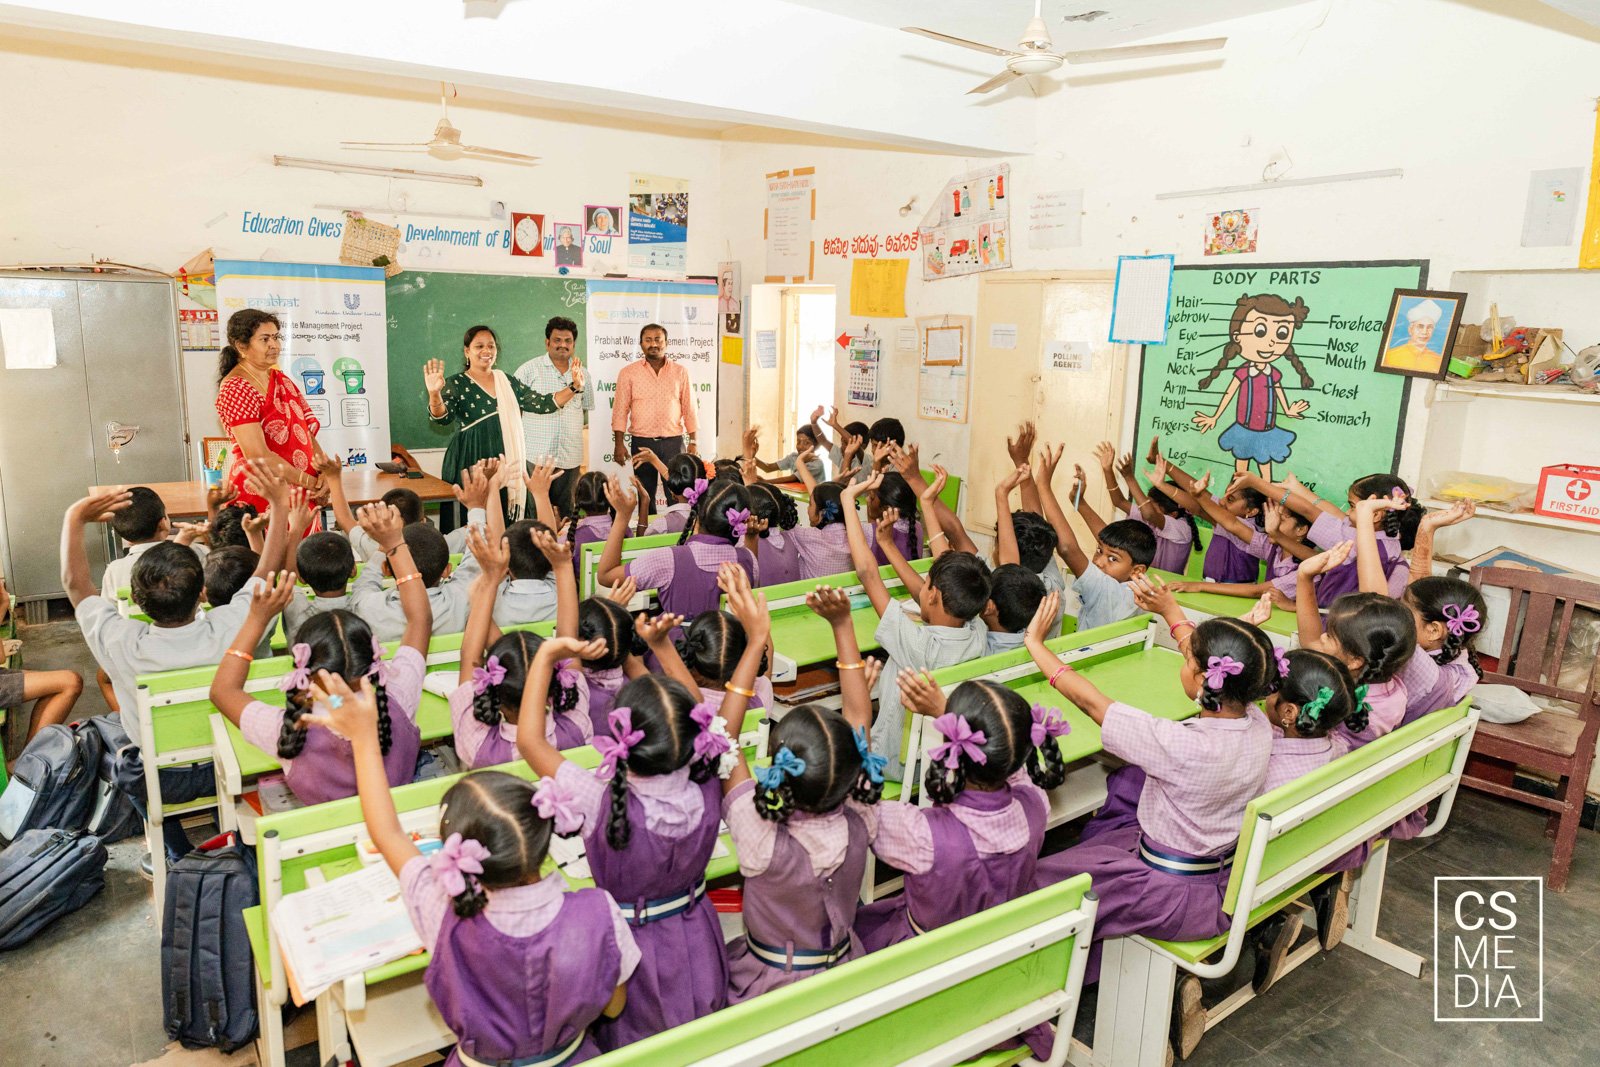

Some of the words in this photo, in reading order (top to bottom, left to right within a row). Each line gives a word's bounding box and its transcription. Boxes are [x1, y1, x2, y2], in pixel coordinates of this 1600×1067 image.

[242, 211, 304, 236] Education
[308, 217, 343, 238] Gives
[486, 230, 500, 248] of
[589, 235, 613, 254] Soul
[1213, 271, 1258, 285] BODY
[1269, 271, 1321, 285] PARTS
[1176, 296, 1203, 308] Hair
[299, 321, 340, 331] Management
[340, 322, 363, 332] Project
[1168, 312, 1210, 329] yebrow
[594, 335, 622, 345] Prabhat
[690, 337, 714, 349] Project
[1179, 328, 1199, 345] Eye
[1327, 337, 1359, 353] Nose
[1053, 352, 1083, 361] POLLING
[1177, 347, 1199, 361] Ear
[1053, 360, 1082, 369] AGENTS
[1167, 362, 1196, 376] Neck
[1325, 353, 1366, 371] Mouth
[700, 382, 712, 392] on
[1163, 380, 1187, 395] Arm
[1321, 383, 1359, 400] Chest
[1160, 396, 1186, 410] Hand
[1152, 416, 1190, 436] Fingers
[1317, 410, 1371, 427] Stomach
[1168, 448, 1189, 467] Leg
[1549, 500, 1580, 512] FIRST
[1580, 505, 1600, 516] AID
